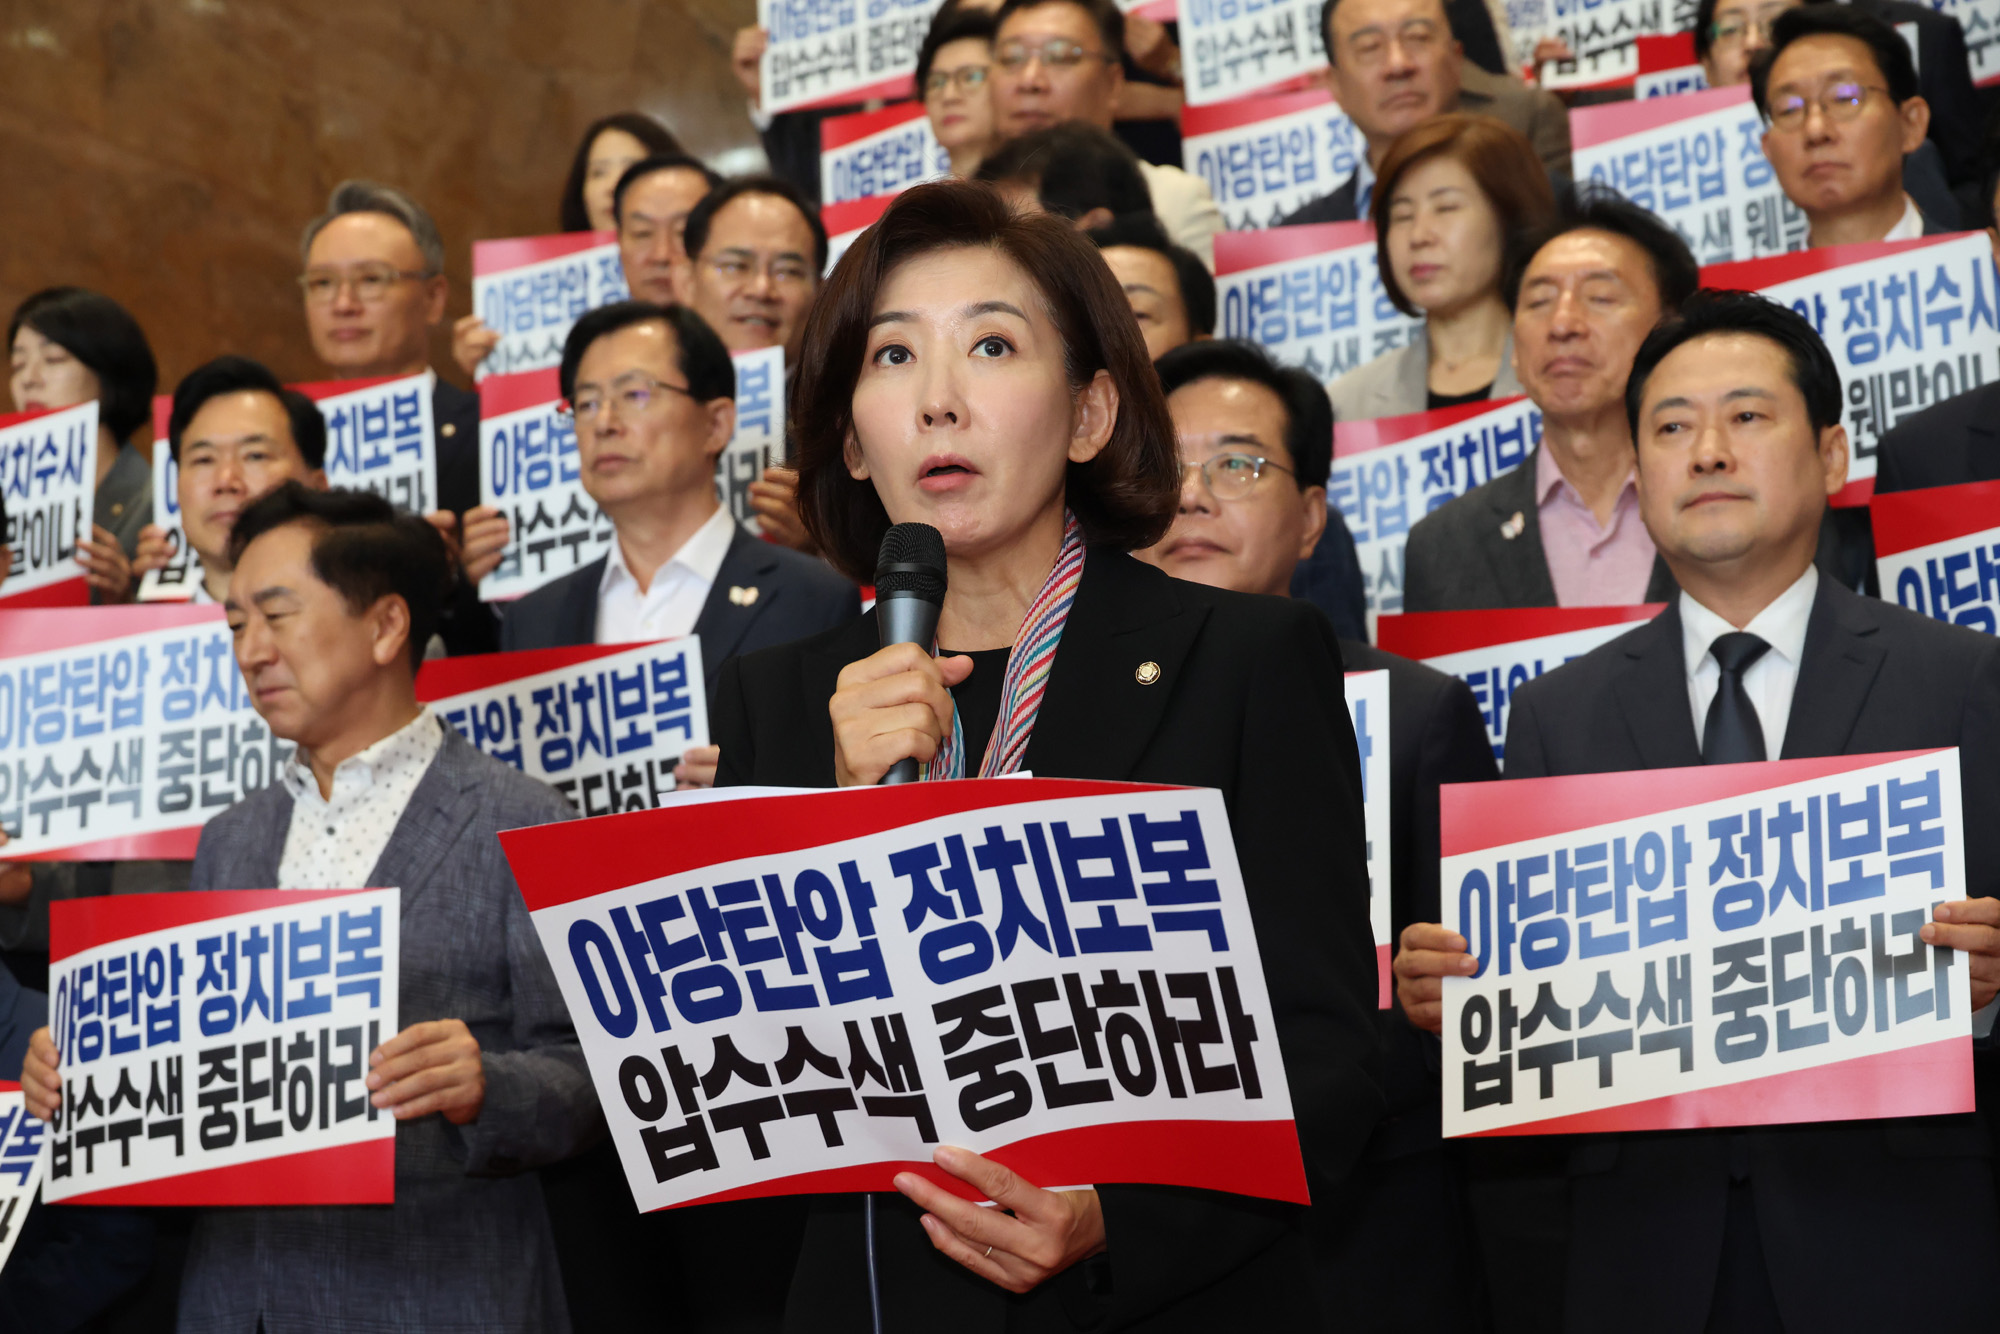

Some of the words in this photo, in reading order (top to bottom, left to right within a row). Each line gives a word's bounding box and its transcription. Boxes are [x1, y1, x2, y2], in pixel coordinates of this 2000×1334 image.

[322, 387, 423, 476] 치보복
[159, 633, 255, 722] 정치
[531, 652, 693, 774] 정치보복
[156, 718, 298, 815] 중단하
[567, 859, 895, 1039] 야당탄압
[887, 809, 1230, 986] 정치보복
[1458, 823, 1693, 980] 야당탄압
[1706, 769, 1947, 933] 정치보복
[53, 941, 185, 1068] 야당탄압
[195, 904, 385, 1038] 정치보복
[1459, 952, 1695, 1114] 압수수색
[1711, 901, 1955, 1066] 중단하라
[51, 1054, 186, 1182] 압수수색
[617, 1011, 940, 1184] 압수수색
[931, 965, 1265, 1134] 중단하라
